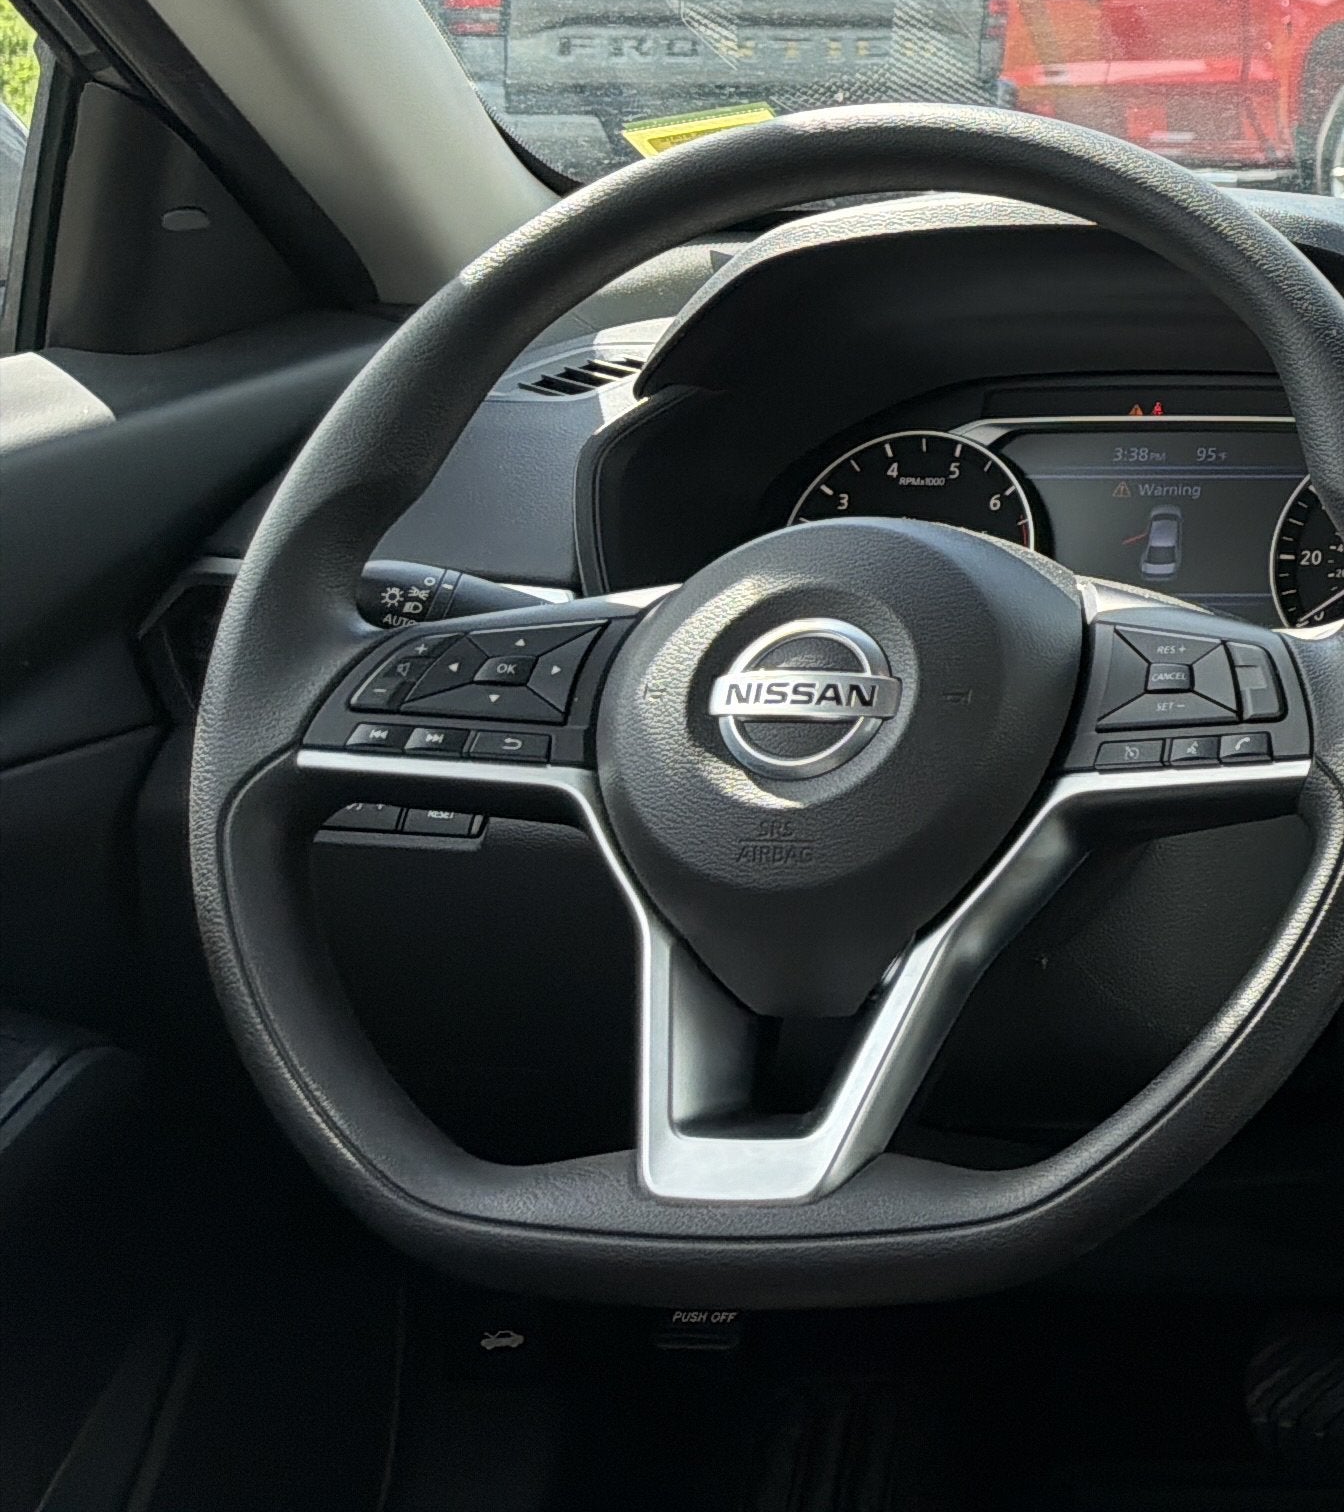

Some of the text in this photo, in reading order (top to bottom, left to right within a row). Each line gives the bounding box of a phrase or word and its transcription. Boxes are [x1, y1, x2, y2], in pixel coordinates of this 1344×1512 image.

[886, 461, 899, 479] 4
[948, 462, 961, 480] 5
[1138, 483, 1202, 500] Warning
[836, 494, 851, 511] 3
[989, 494, 1001, 511] 6
[1300, 549, 1322, 566] 20
[496, 663, 517, 675] OK
[1151, 670, 1188, 682] CANCEL
[724, 682, 878, 707] NISSAN
[758, 821, 794, 837] SRS
[735, 845, 813, 863] AIRBAG
[672, 1311, 738, 1324] PUSH OFF
